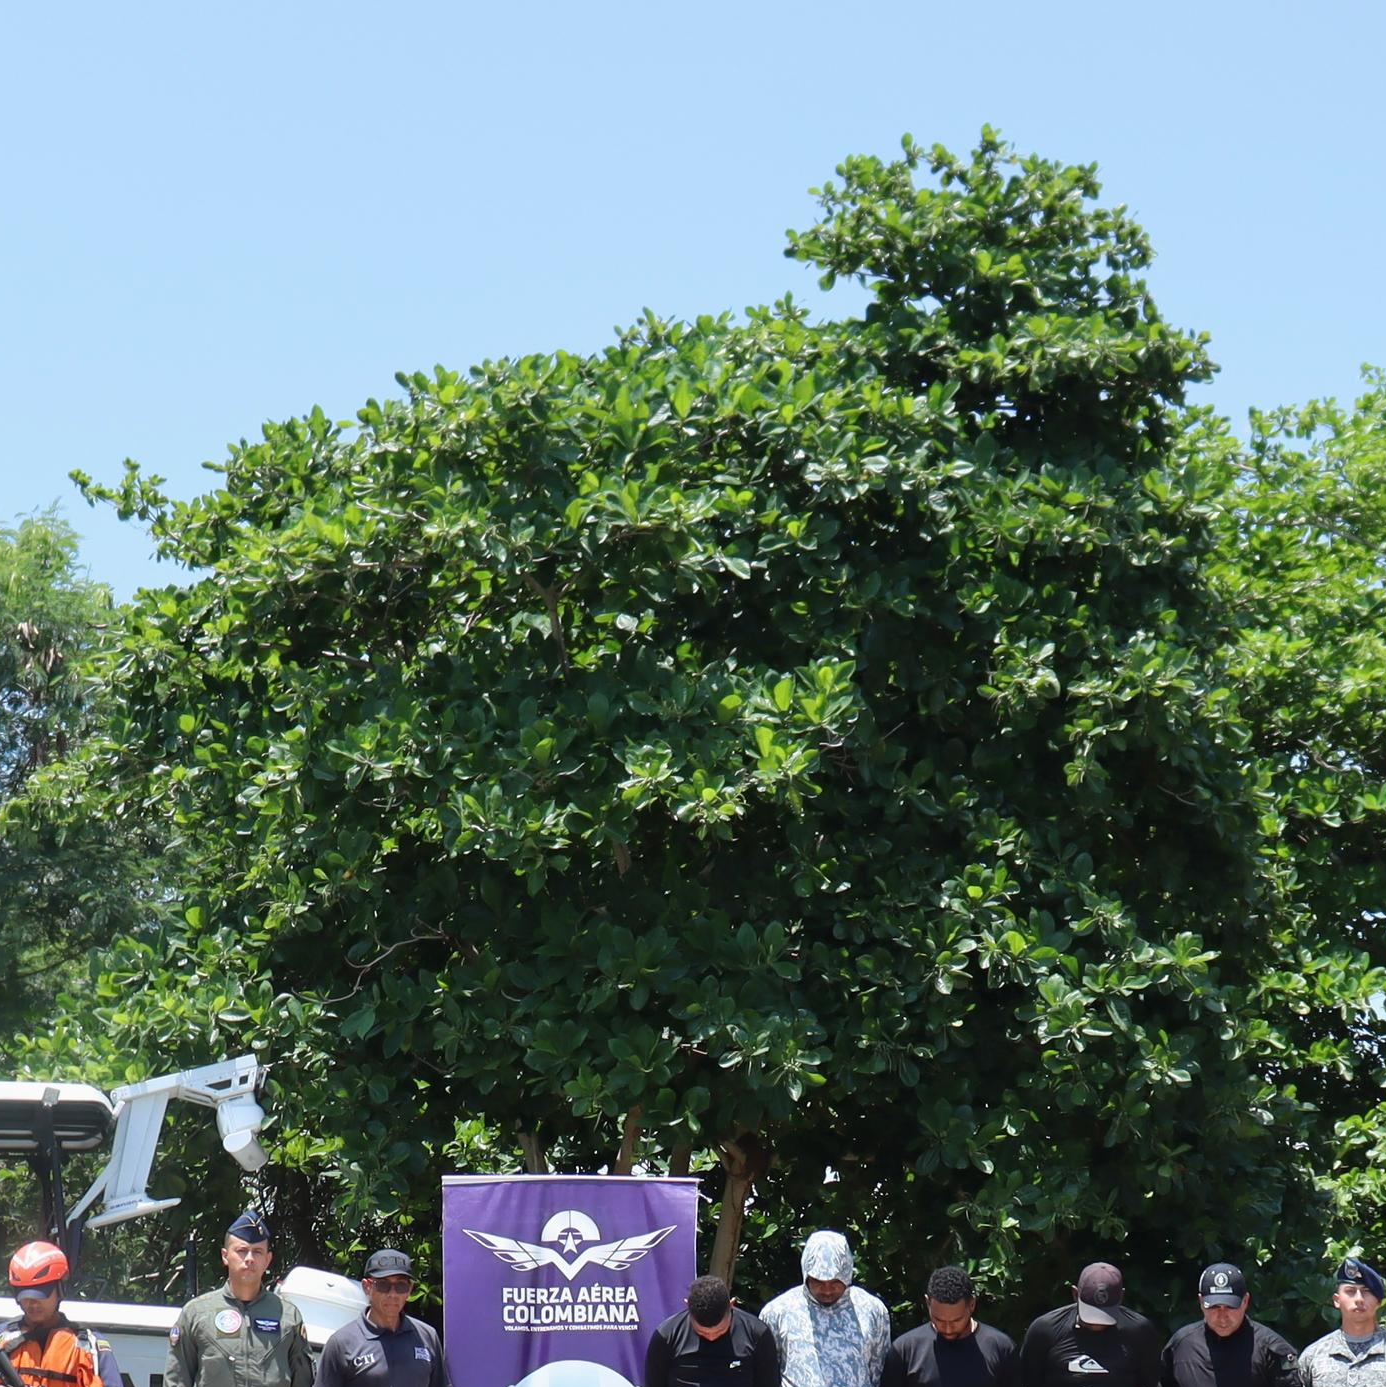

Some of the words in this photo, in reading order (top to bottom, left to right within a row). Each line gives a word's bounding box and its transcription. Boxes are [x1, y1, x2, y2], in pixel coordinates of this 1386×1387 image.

[377, 1256, 406, 1267] CTI
[502, 1287, 573, 1304] FUERZA
[577, 1283, 638, 1303] AÉREA
[503, 1304, 640, 1324] COLOMBIANA
[353, 1353, 376, 1367] CTI
